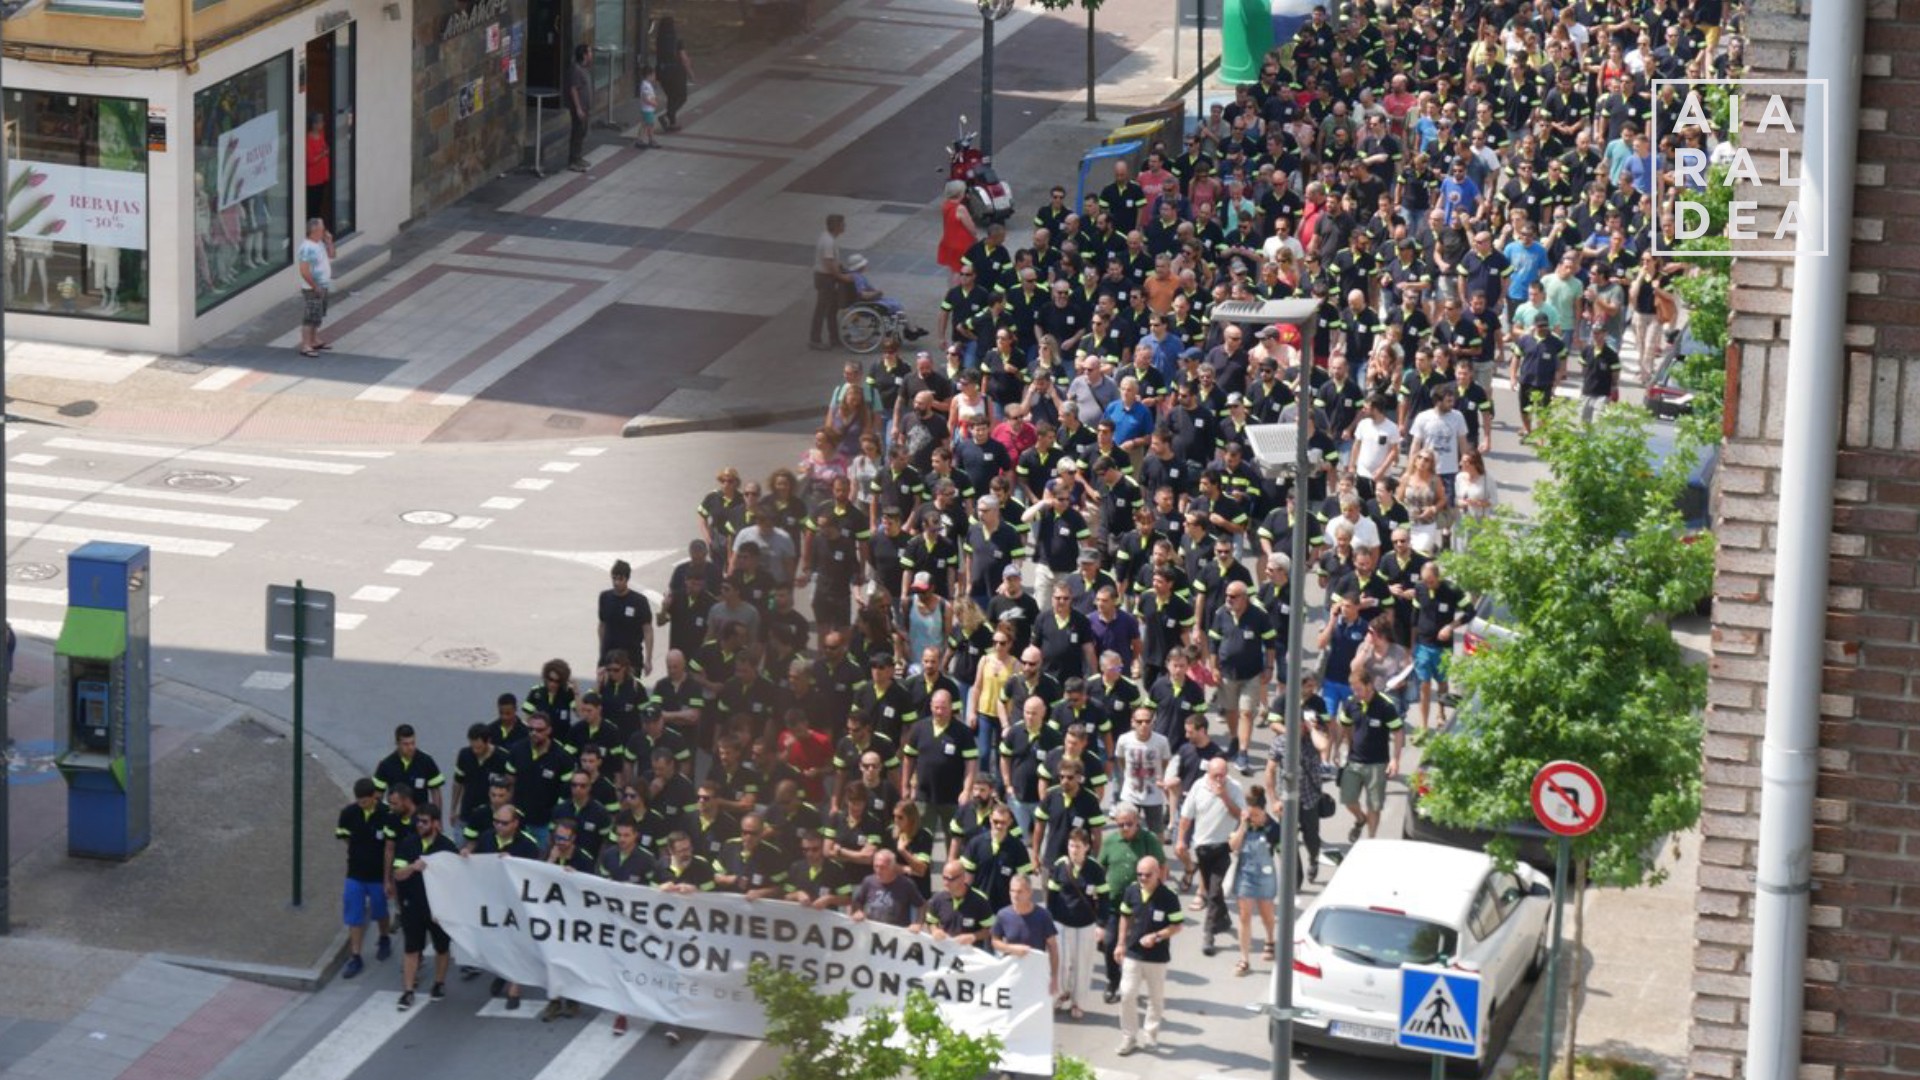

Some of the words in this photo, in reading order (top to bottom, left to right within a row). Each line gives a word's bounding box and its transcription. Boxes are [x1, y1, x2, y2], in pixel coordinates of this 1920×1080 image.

[69, 194, 141, 215] REBAJAS
[480, 905, 520, 931] LA
[529, 916, 731, 973] DIRECCIÓN
[521, 878, 567, 907] LA
[581, 889, 855, 952] PRECARIEDAD
[622, 968, 699, 997] COMITÉ
[713, 987, 745, 1001] DE
